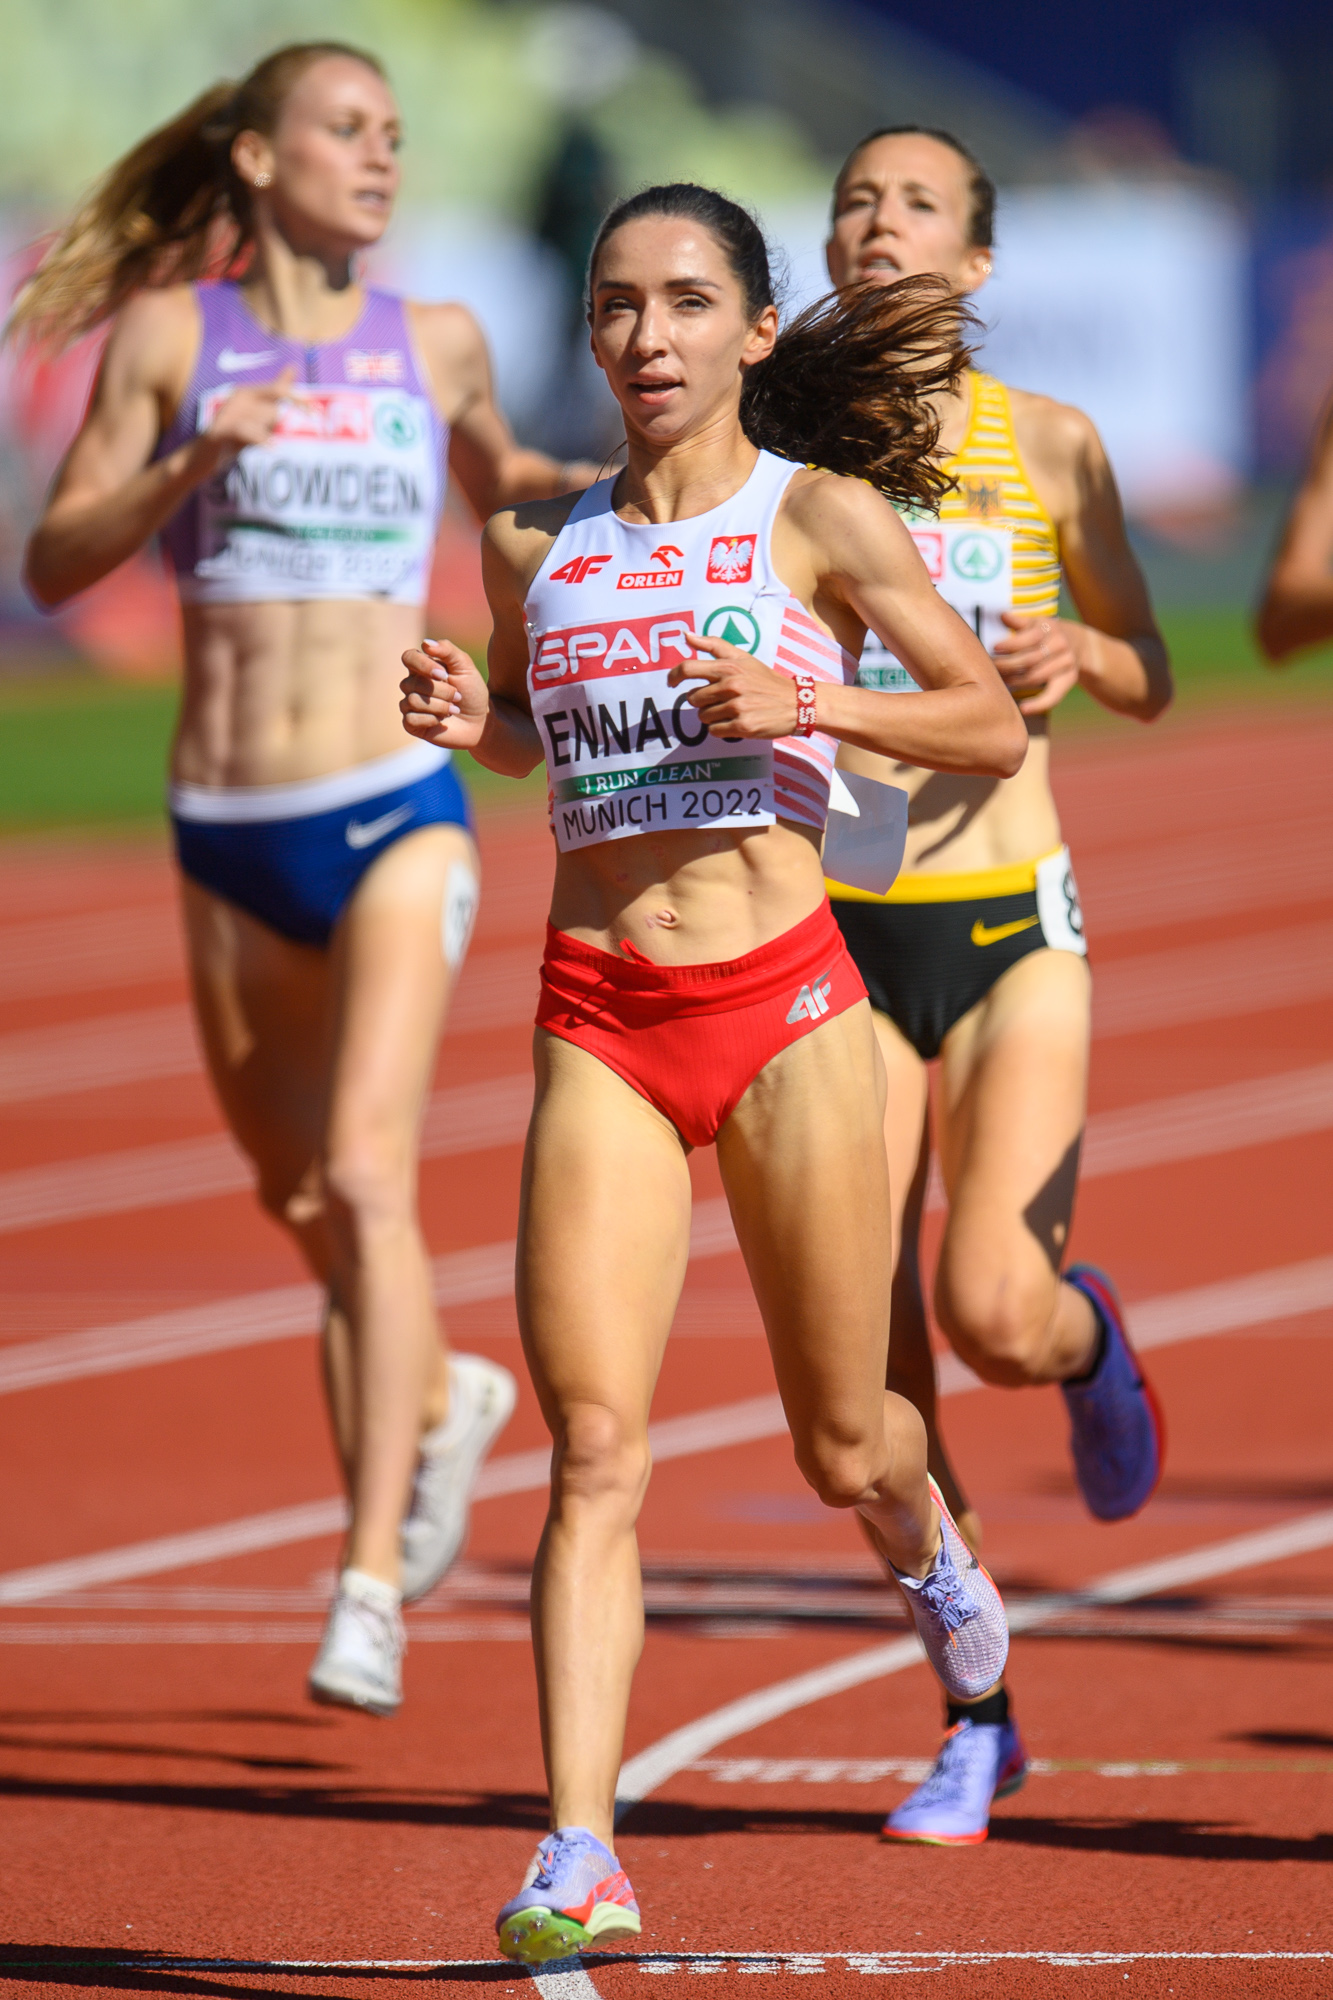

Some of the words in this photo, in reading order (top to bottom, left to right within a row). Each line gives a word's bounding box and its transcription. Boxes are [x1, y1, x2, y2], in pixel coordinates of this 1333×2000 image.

[224, 459, 421, 515] NOWDEN
[549, 555, 613, 584] 4F
[620, 573, 680, 588] ORLEN
[535, 620, 692, 681] SPAR
[543, 692, 745, 767] ENNAO
[585, 778, 592, 794] I
[596, 772, 639, 791] RUN
[563, 792, 667, 840] MUNICH
[682, 788, 761, 818] 2022
[785, 968, 832, 1025] 4F
